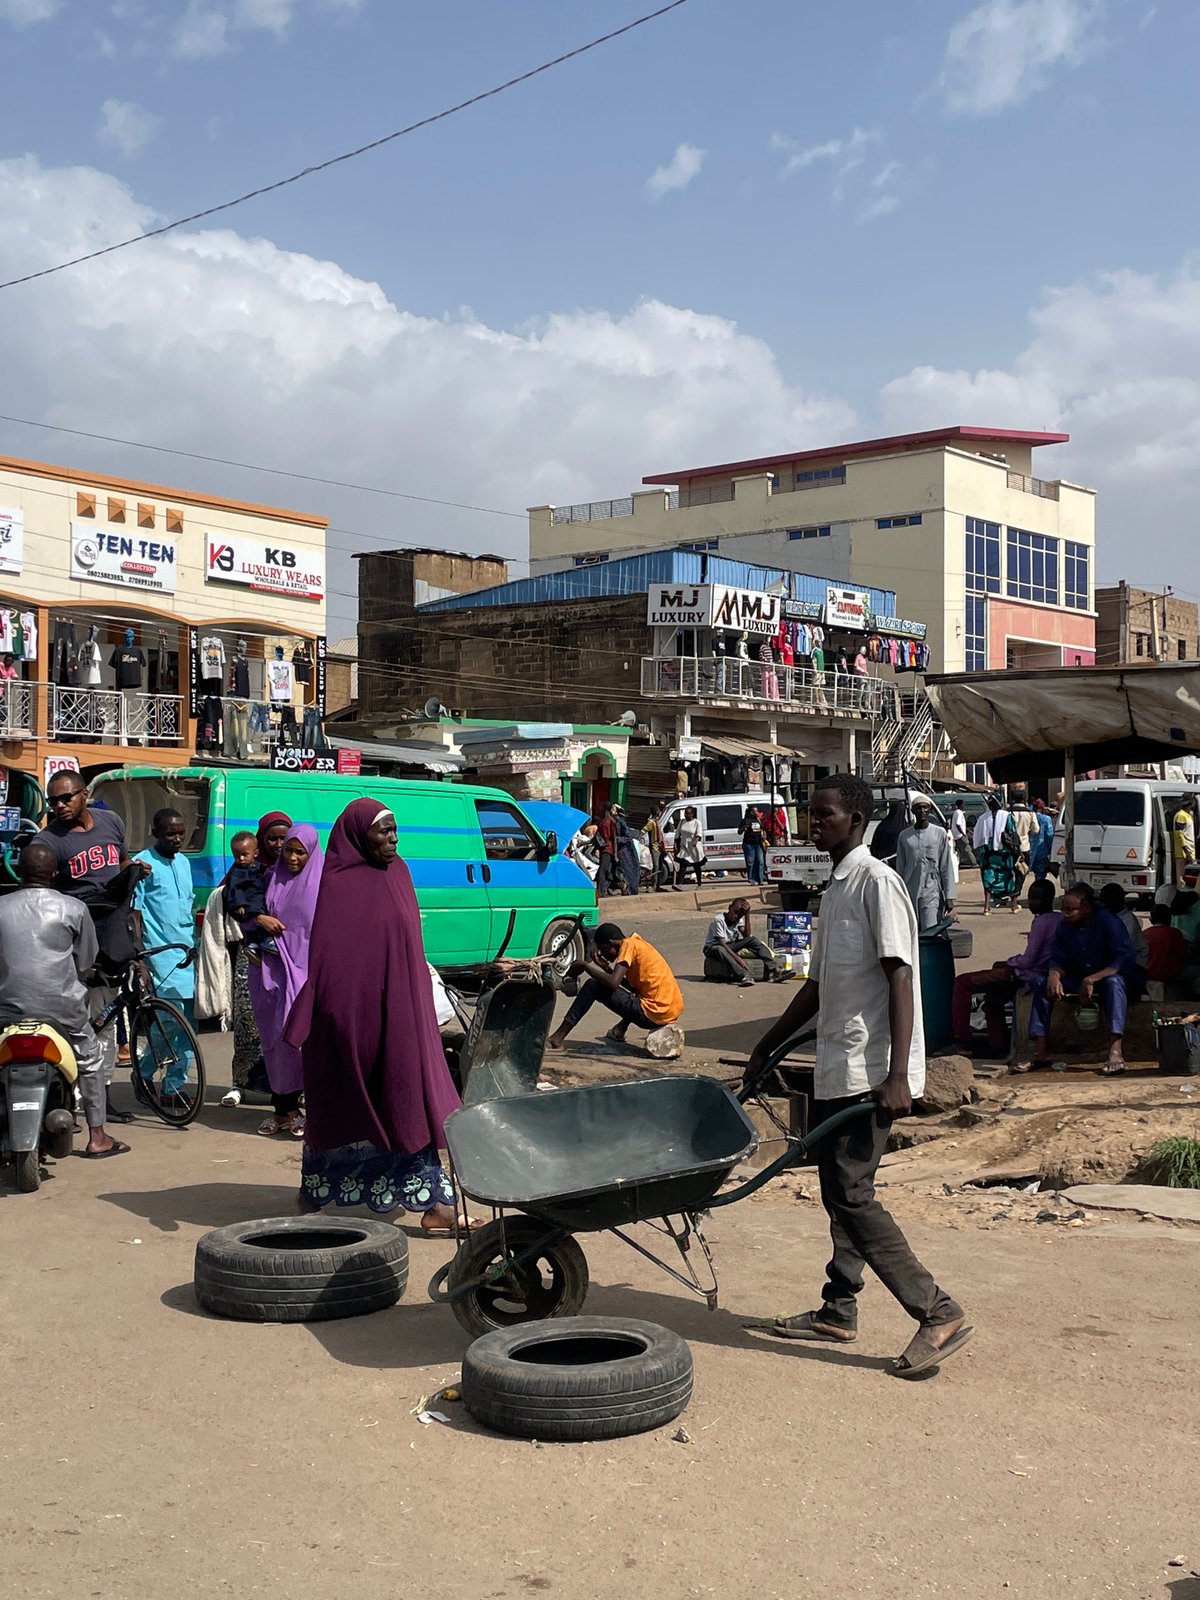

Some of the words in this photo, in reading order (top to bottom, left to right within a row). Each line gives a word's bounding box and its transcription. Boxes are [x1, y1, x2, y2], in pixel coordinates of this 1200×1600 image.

[96, 533, 132, 556] TEN
[138, 540, 174, 563] TEN
[265, 547, 296, 568] KB
[124, 562, 156, 573] COLLECTION
[242, 562, 283, 580] LUXURY
[285, 570, 322, 587] WEARS
[254, 576, 285, 587] WHOLESALE
[660, 590, 699, 608] MJ
[741, 594, 776, 621] MJ
[651, 612, 705, 623] LUXURY
[743, 619, 778, 634] LUXURY
[277, 748, 315, 758] WORLD
[49, 760, 75, 773] POS
[275, 757, 335, 769] POWER
[69, 843, 120, 879] USA
[772, 855, 792, 864] GDS
[794, 854, 812, 863] PRIME
